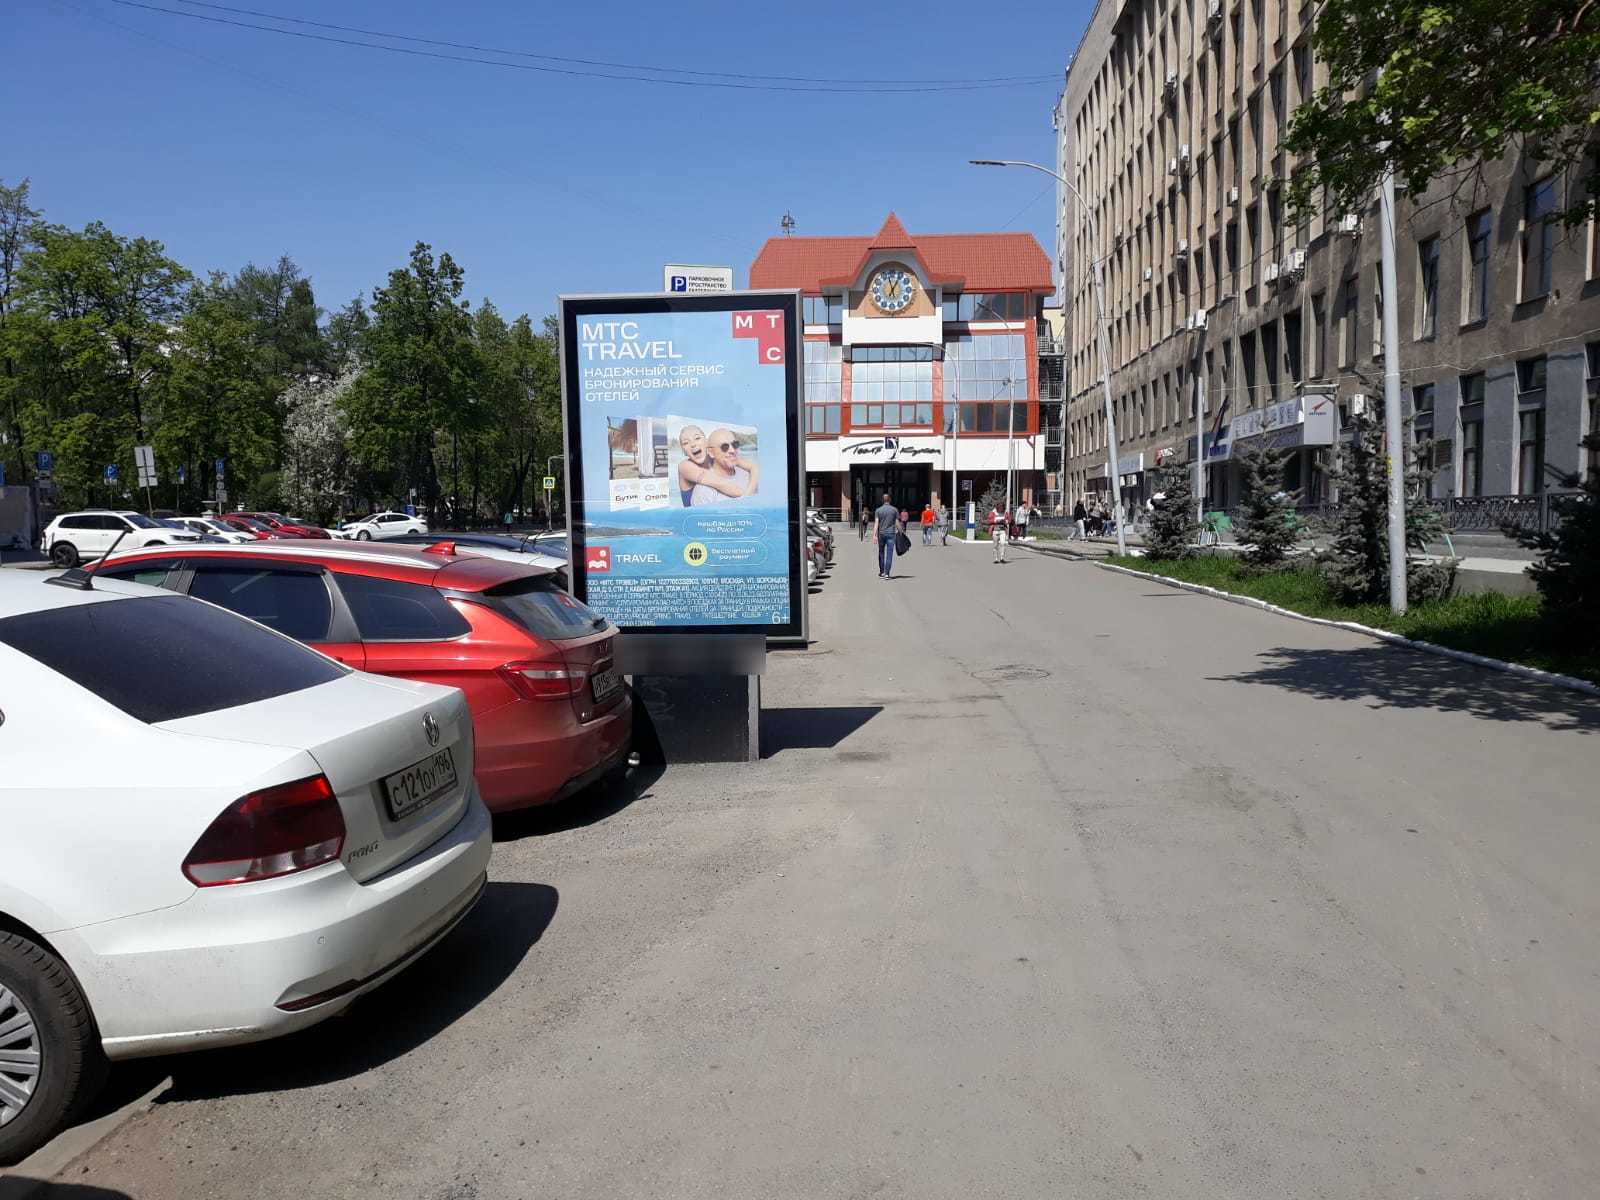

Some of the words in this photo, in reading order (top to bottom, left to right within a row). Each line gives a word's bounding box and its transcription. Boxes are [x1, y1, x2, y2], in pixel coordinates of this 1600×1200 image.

[582, 321, 640, 341] МТС
[582, 341, 683, 360] TRAVEL
[584, 364, 667, 378] НАДЕЖНЫЙ
[669, 364, 725, 375] СЕРВИС
[584, 377, 699, 390] БРОНИРОВАНИЯ
[585, 389, 640, 402] ОТЕЛЕЙ
[616, 553, 662, 564] TRAVEL
[771, 611, 788, 624] 6+
